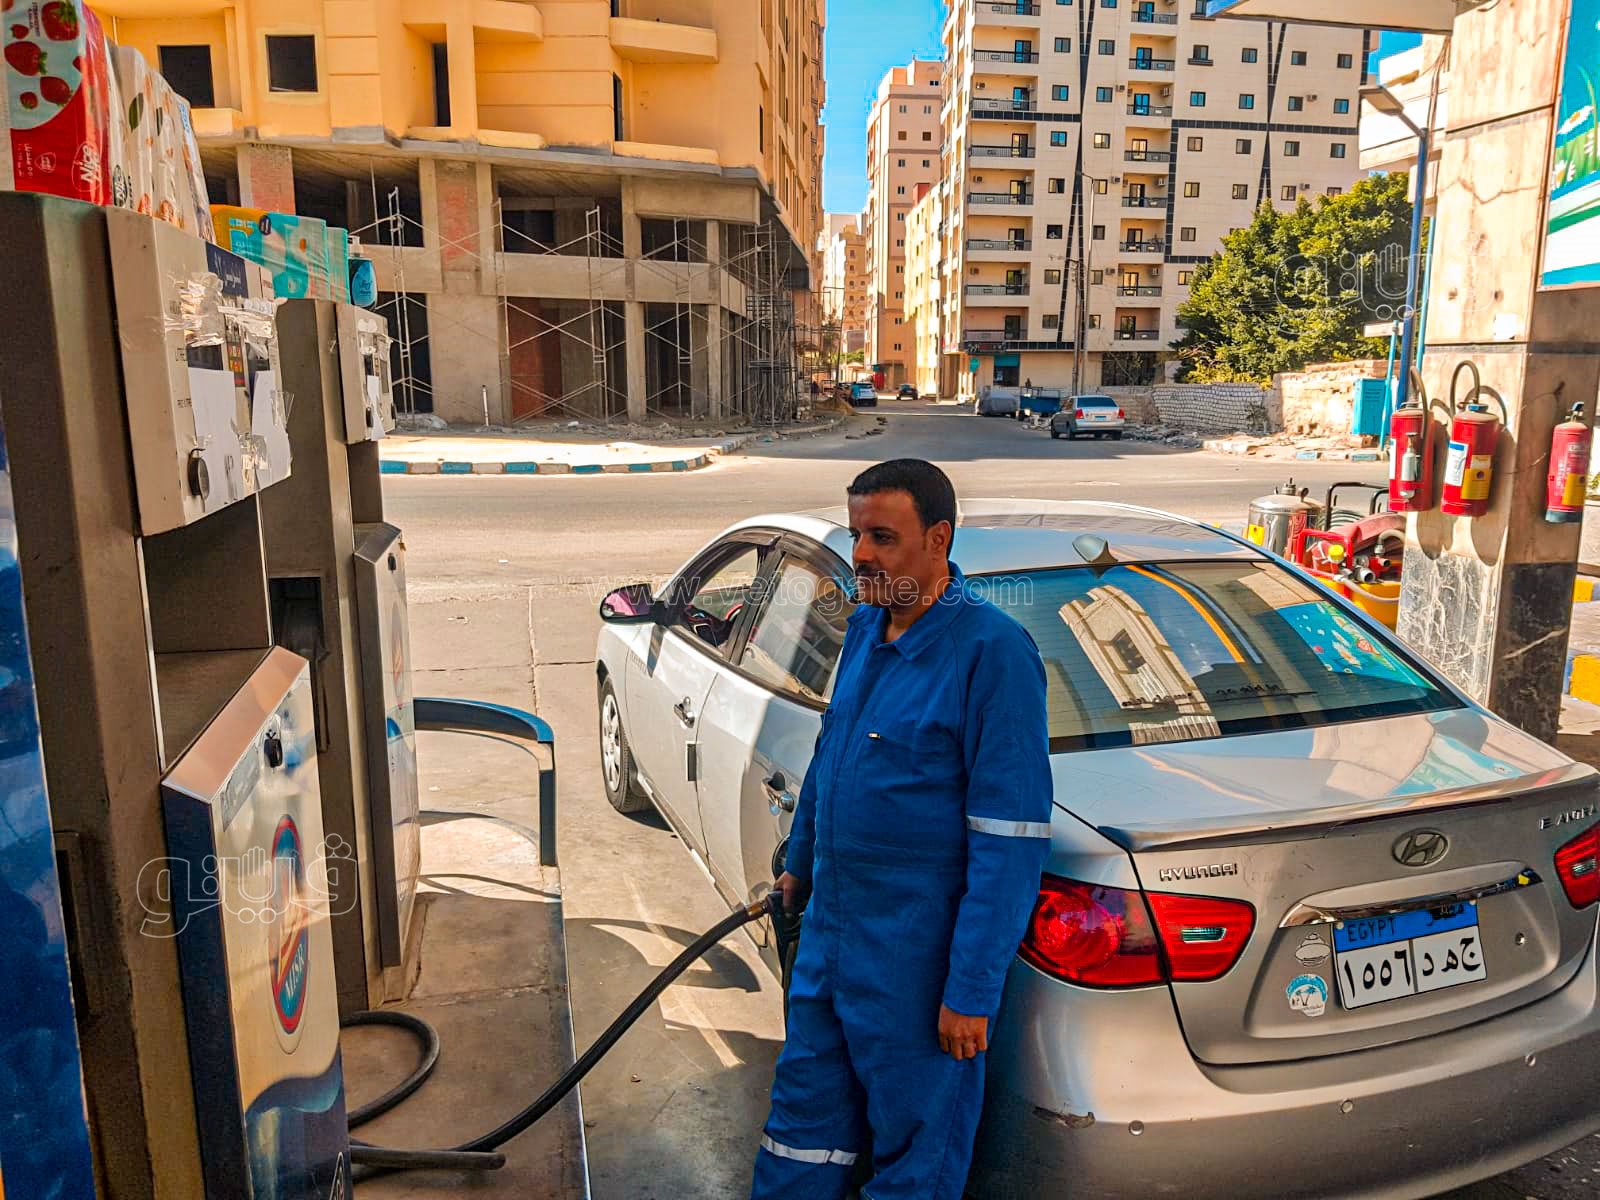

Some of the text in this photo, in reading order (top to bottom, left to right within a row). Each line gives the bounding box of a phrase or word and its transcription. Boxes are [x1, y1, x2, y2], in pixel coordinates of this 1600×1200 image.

[1159, 863, 1238, 882] HYUNDAI
[1346, 917, 1396, 943] EGYPT
[1343, 948, 1412, 999] ١٥٥٦
